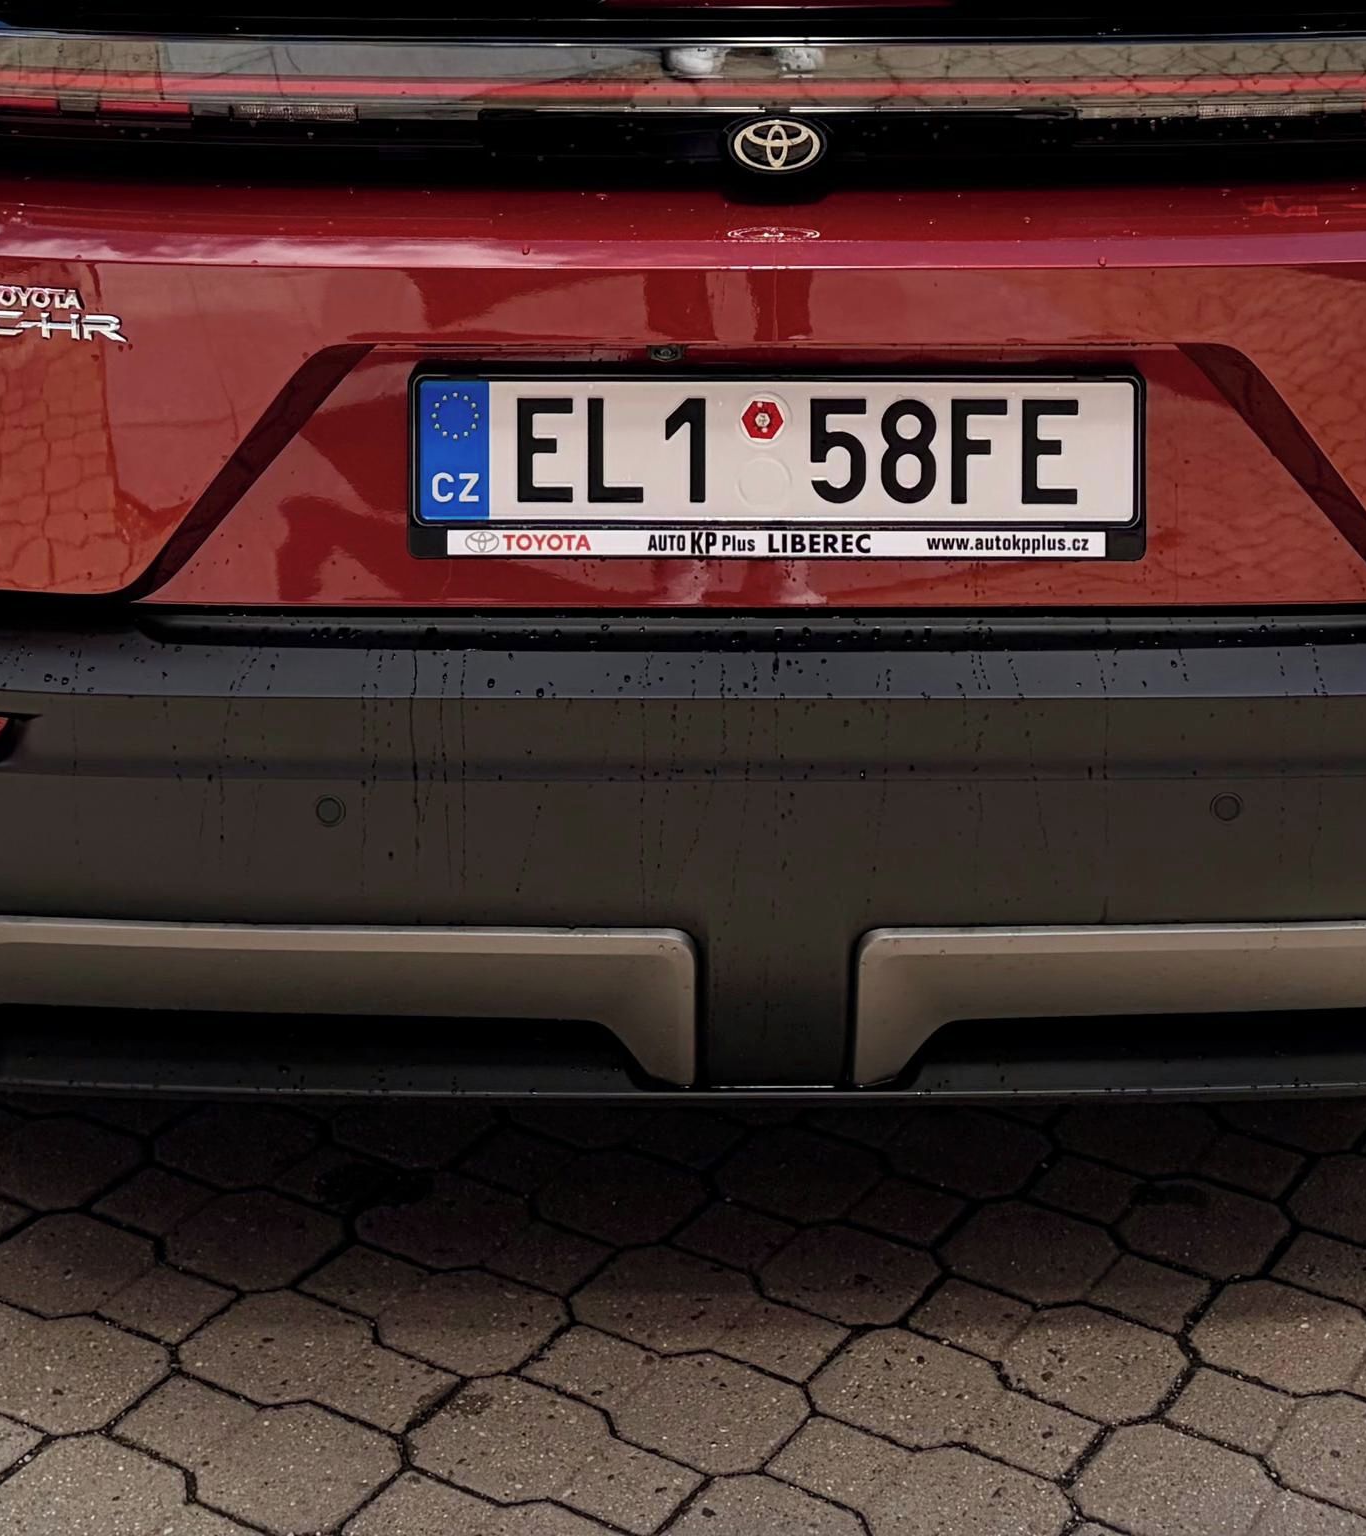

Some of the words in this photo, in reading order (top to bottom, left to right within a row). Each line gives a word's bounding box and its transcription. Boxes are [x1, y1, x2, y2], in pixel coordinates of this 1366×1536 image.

[516, 397, 706, 505] EL1
[809, 398, 1078, 505] 58FE
[431, 472, 481, 504] CZ
[502, 534, 592, 552] TOYOTA
[647, 534, 686, 552] AUTO
[690, 531, 718, 555] KP
[722, 534, 756, 552] Plus
[767, 534, 872, 554] LIBEREC
[926, 533, 1090, 555] www.autokpplus.cz
